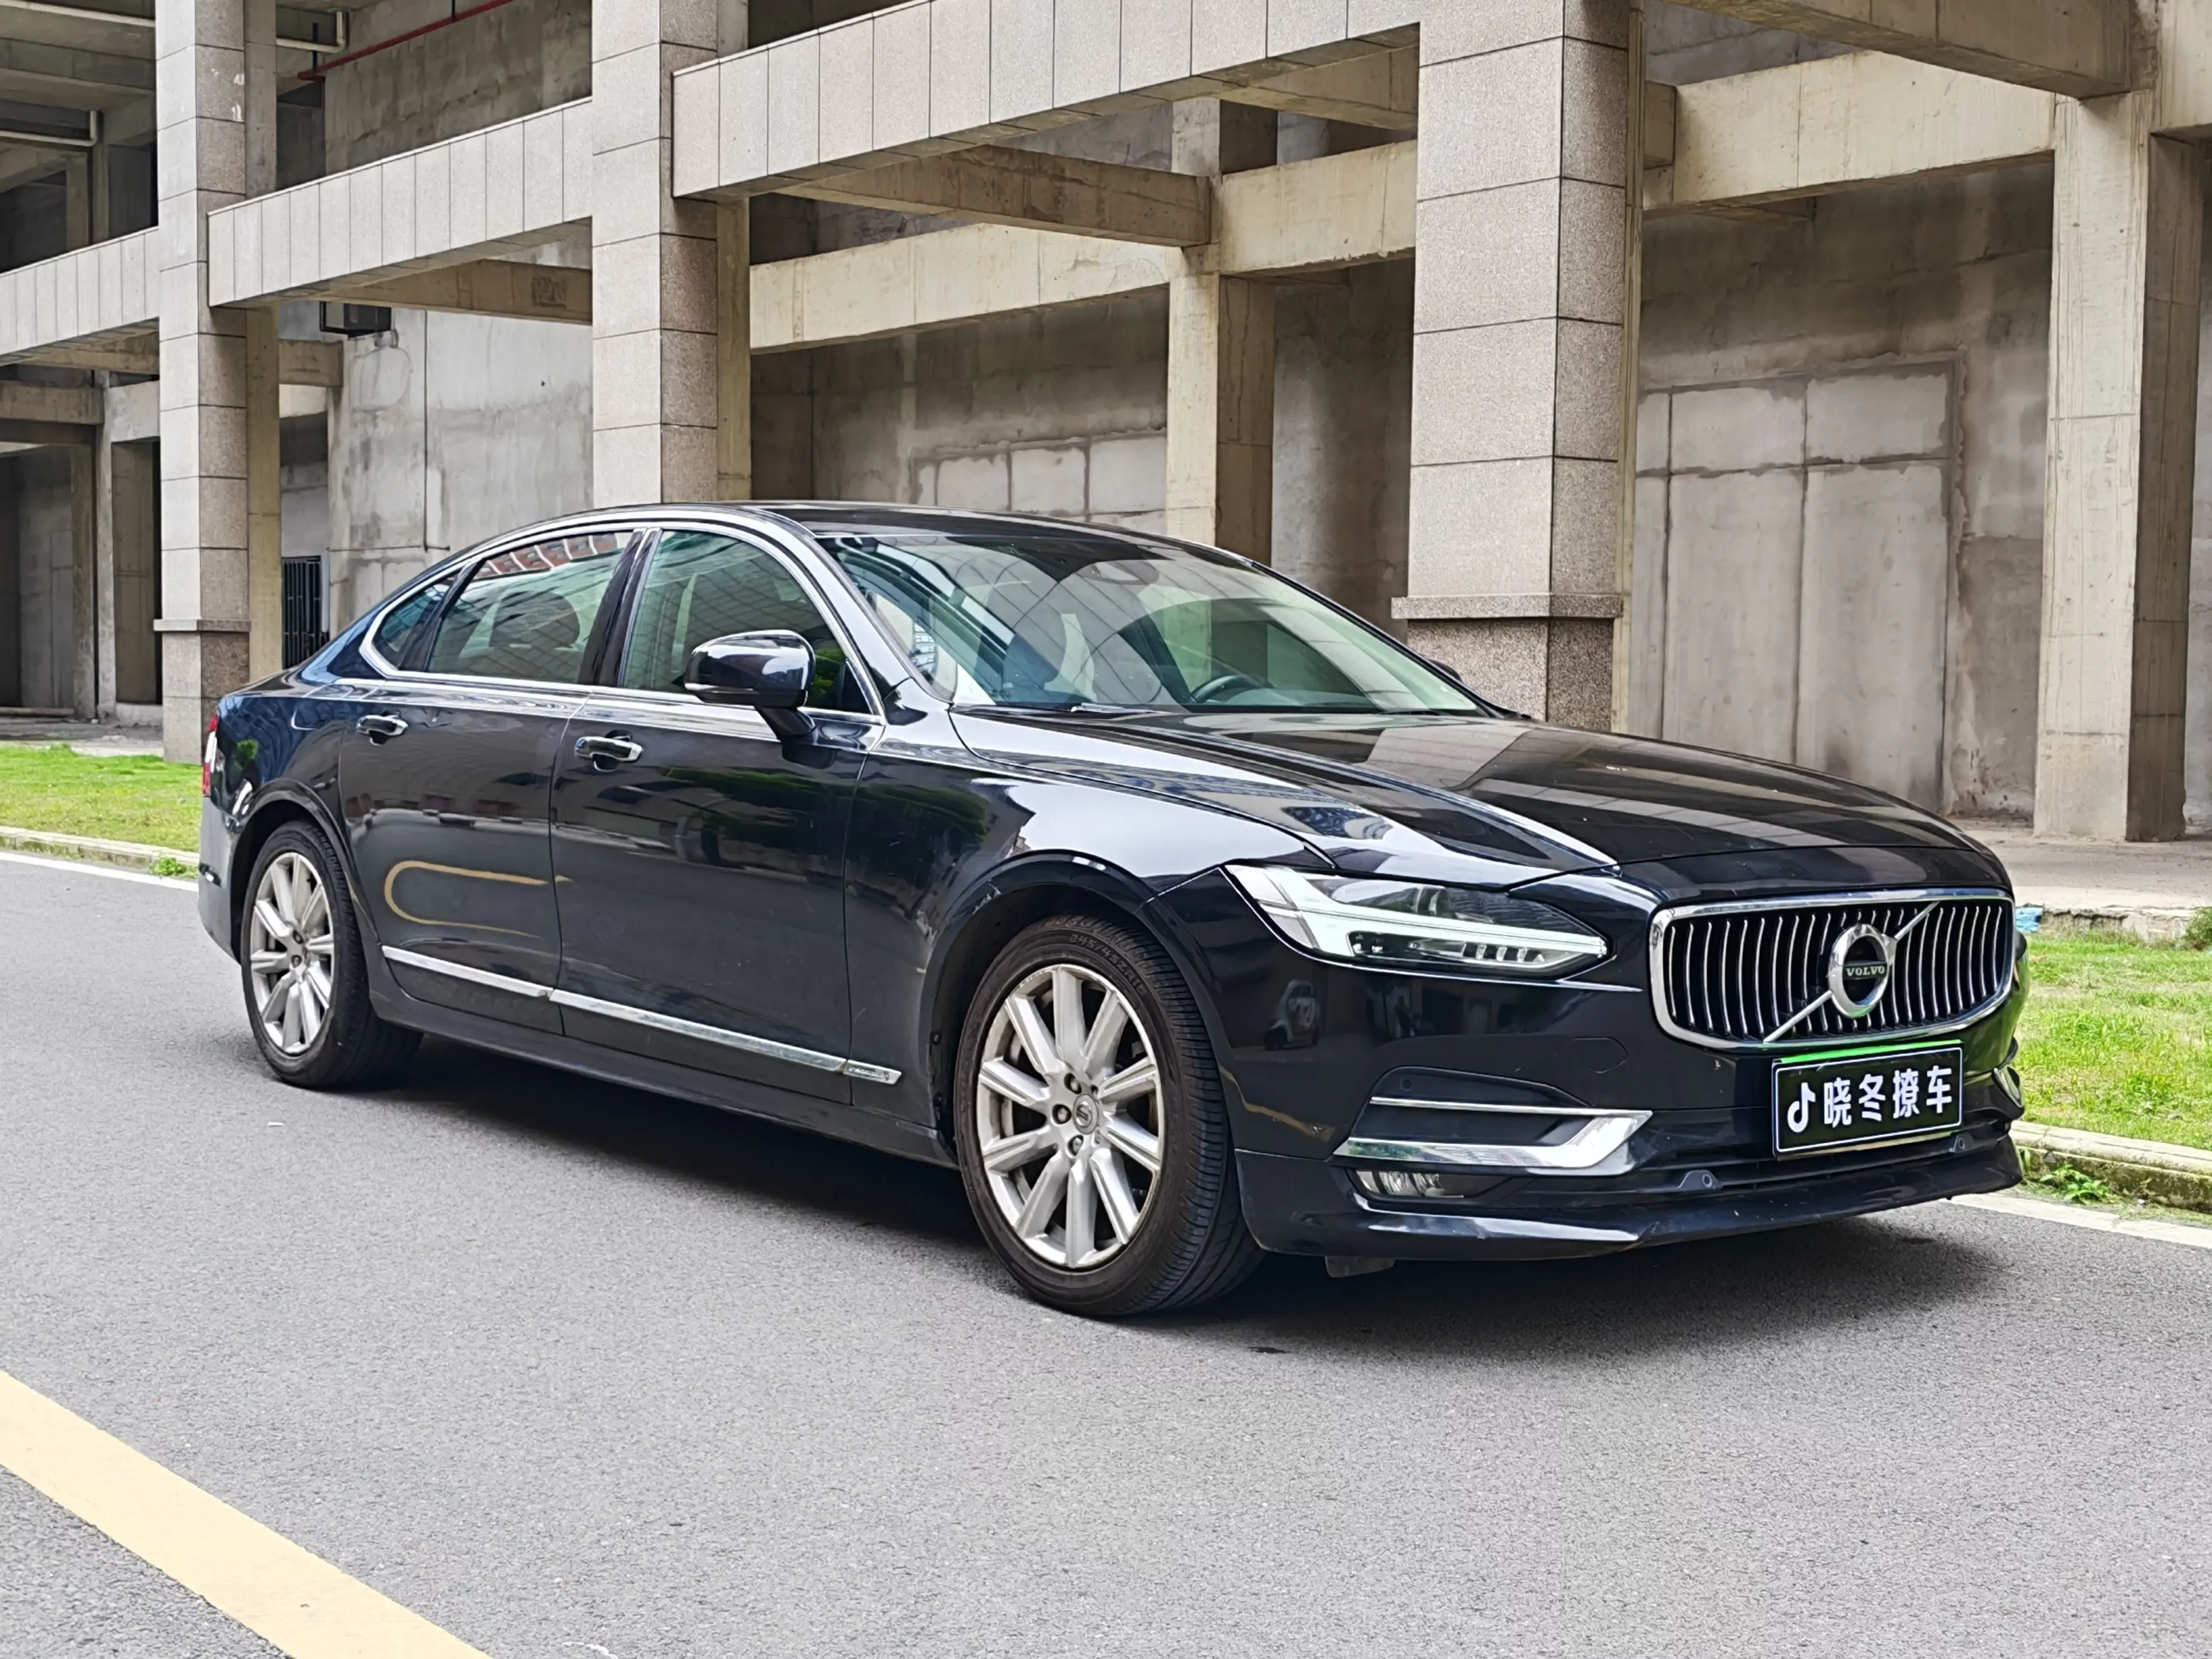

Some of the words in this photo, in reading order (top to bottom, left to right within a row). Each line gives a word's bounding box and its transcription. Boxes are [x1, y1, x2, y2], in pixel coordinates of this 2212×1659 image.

[1845, 966, 1885, 976] VOLVO
[1823, 1065, 1952, 1128] 晓冬撩车
